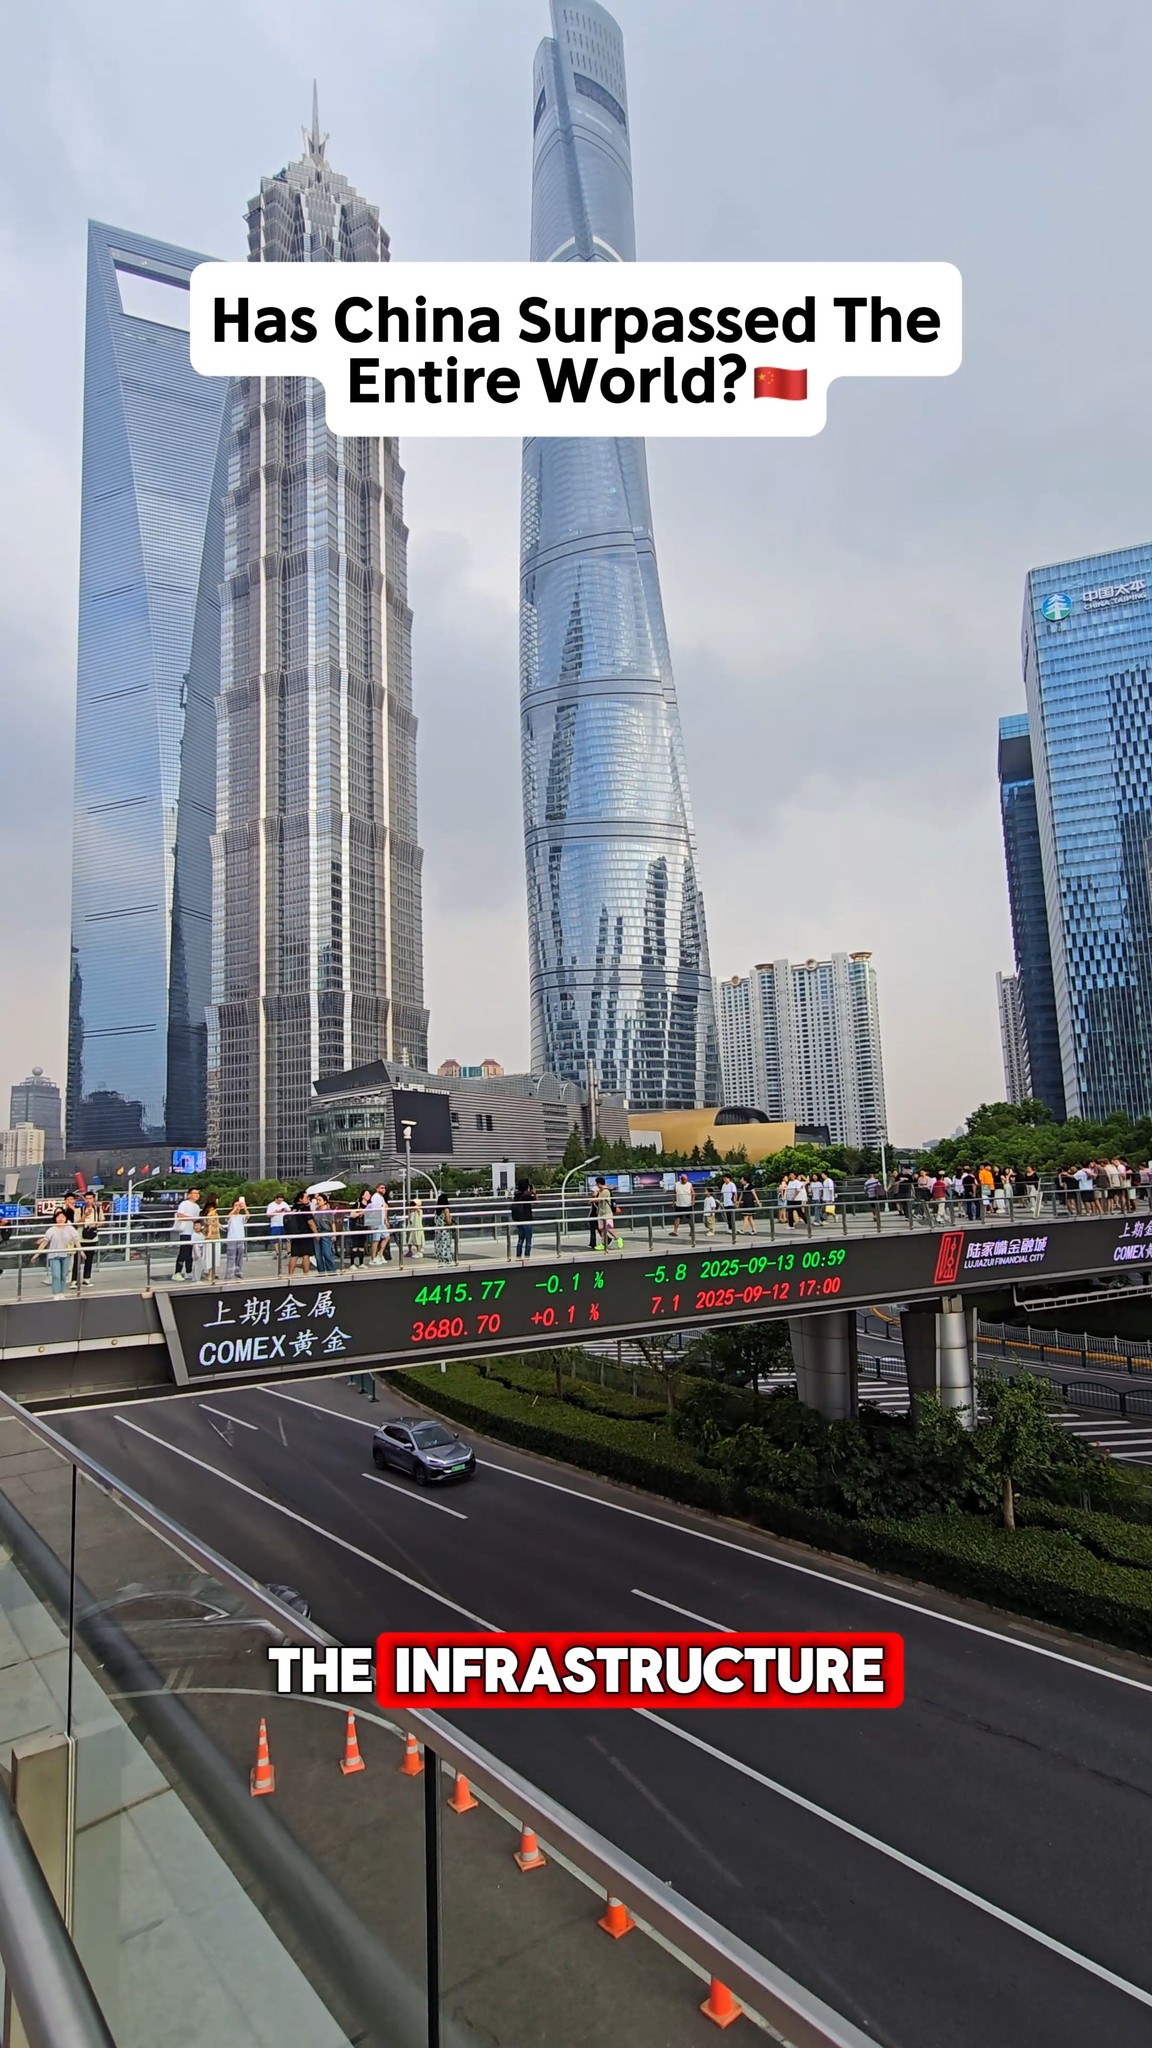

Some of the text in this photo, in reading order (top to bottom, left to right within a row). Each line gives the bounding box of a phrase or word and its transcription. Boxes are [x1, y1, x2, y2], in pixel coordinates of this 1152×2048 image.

[1082, 579, 1146, 602] 中国太平
[1083, 591, 1148, 612] CHINA TAIPING
[966, 1236, 1048, 1259] 陆家嘴金融城
[963, 1253, 1045, 1269] LUJIAZUI FINANCIAL CITY
[203, 1290, 336, 1327] 上期金属
[414, 1280, 506, 1306] 4415.77
[535, 1272, 580, 1294] -0.1
[644, 1263, 687, 1284] -5.8
[700, 1253, 795, 1279] 2025-09-13
[802, 1249, 846, 1269] 00:59
[411, 1313, 501, 1342] 3680.70
[530, 1304, 575, 1327] +0.1
[651, 1294, 680, 1314] 7.1
[695, 1282, 790, 1309] 2025-09-12
[799, 1277, 841, 1297] 17:00
